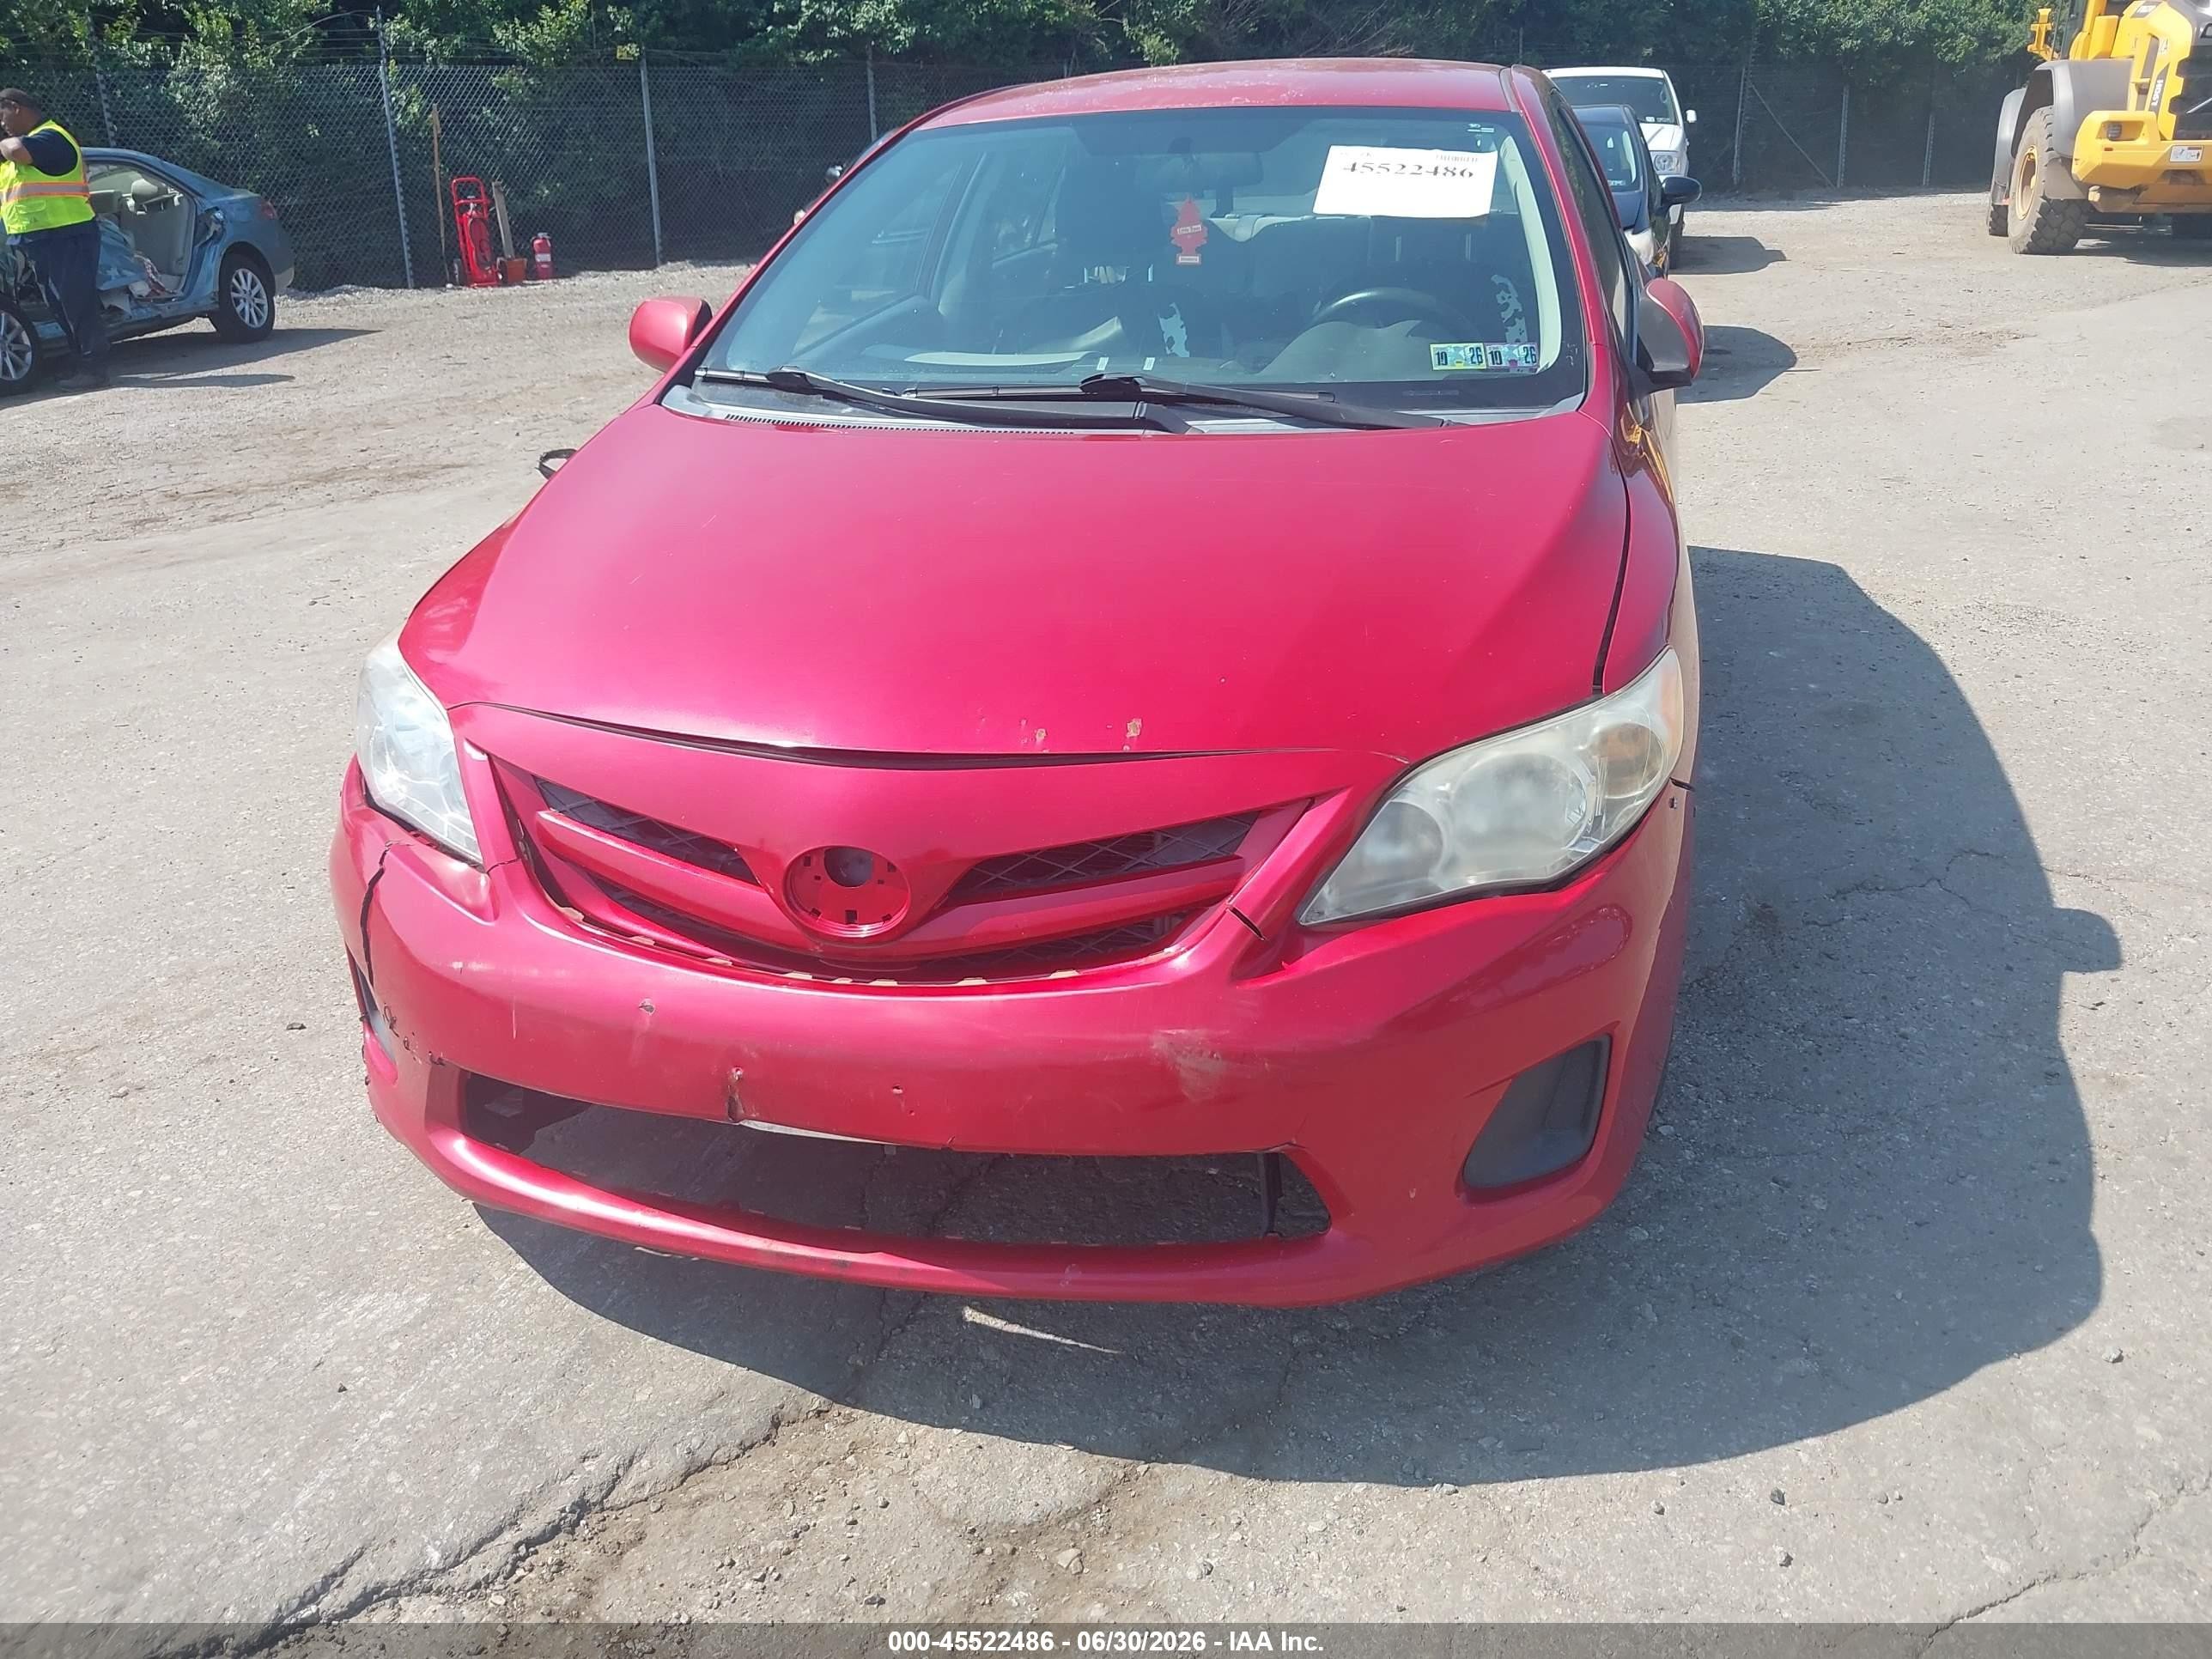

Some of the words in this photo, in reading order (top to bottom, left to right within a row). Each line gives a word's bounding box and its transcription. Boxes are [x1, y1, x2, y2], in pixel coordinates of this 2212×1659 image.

[1342, 161, 1474, 179] 45522486
[1468, 346, 1483, 364] 26
[1488, 350, 1503, 365] 10
[1522, 346, 1537, 364] 26
